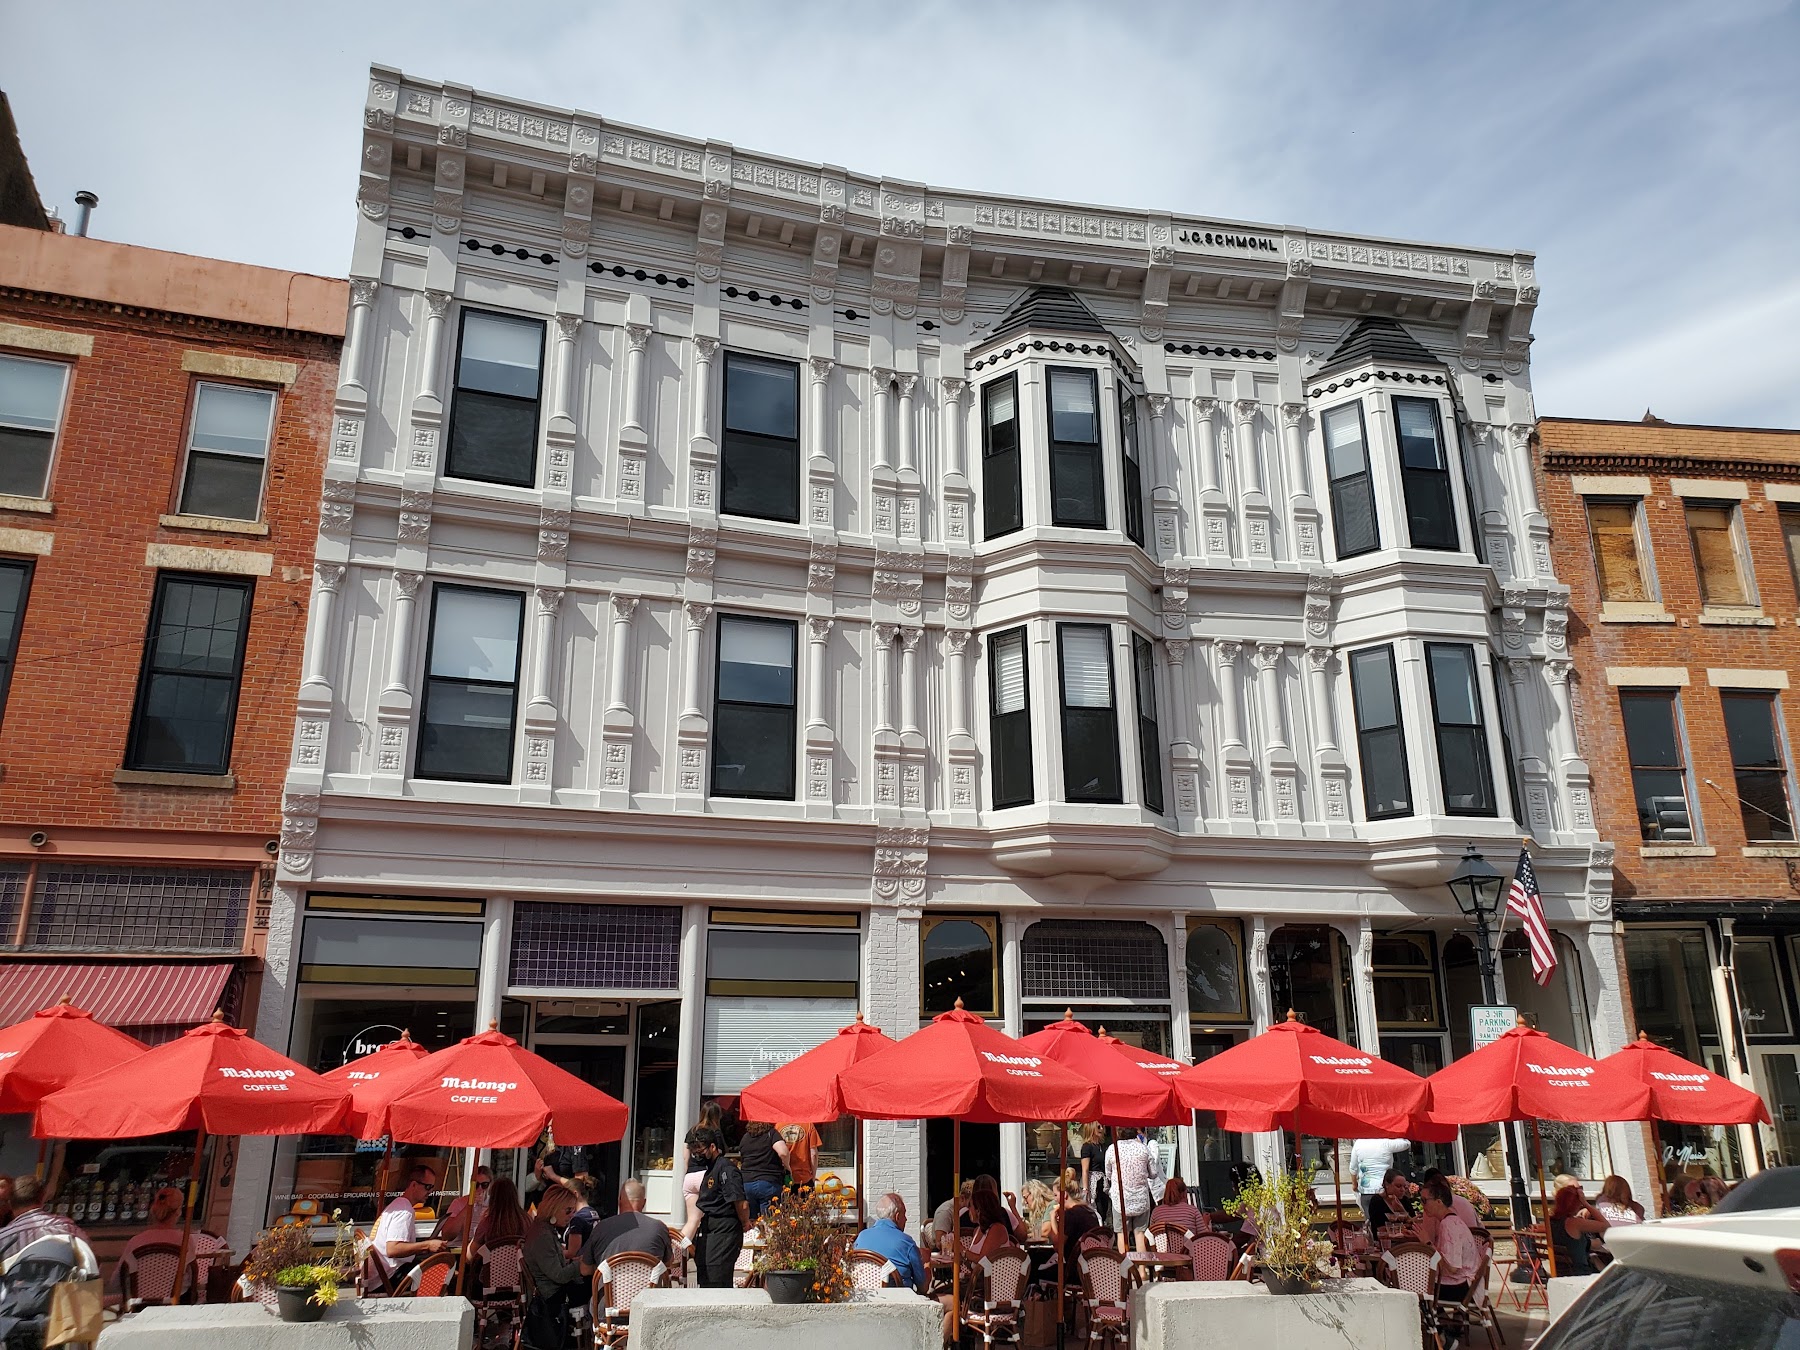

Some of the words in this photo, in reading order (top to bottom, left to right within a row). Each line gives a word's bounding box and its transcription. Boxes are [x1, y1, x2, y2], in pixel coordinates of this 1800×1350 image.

[1485, 1010, 1491, 1018] 3
[1479, 1019, 1511, 1027] PARKING
[981, 1051, 1043, 1068] Malongo
[1308, 1055, 1373, 1067] Malongo
[218, 1067, 296, 1081] Malongo
[1525, 1063, 1595, 1077] Malongo
[1649, 1071, 1711, 1084] Malongo
[440, 1077, 518, 1093] Malongo
[450, 1095, 498, 1104] COFFEE
[343, 1191, 375, 1199] EPICUREAN
